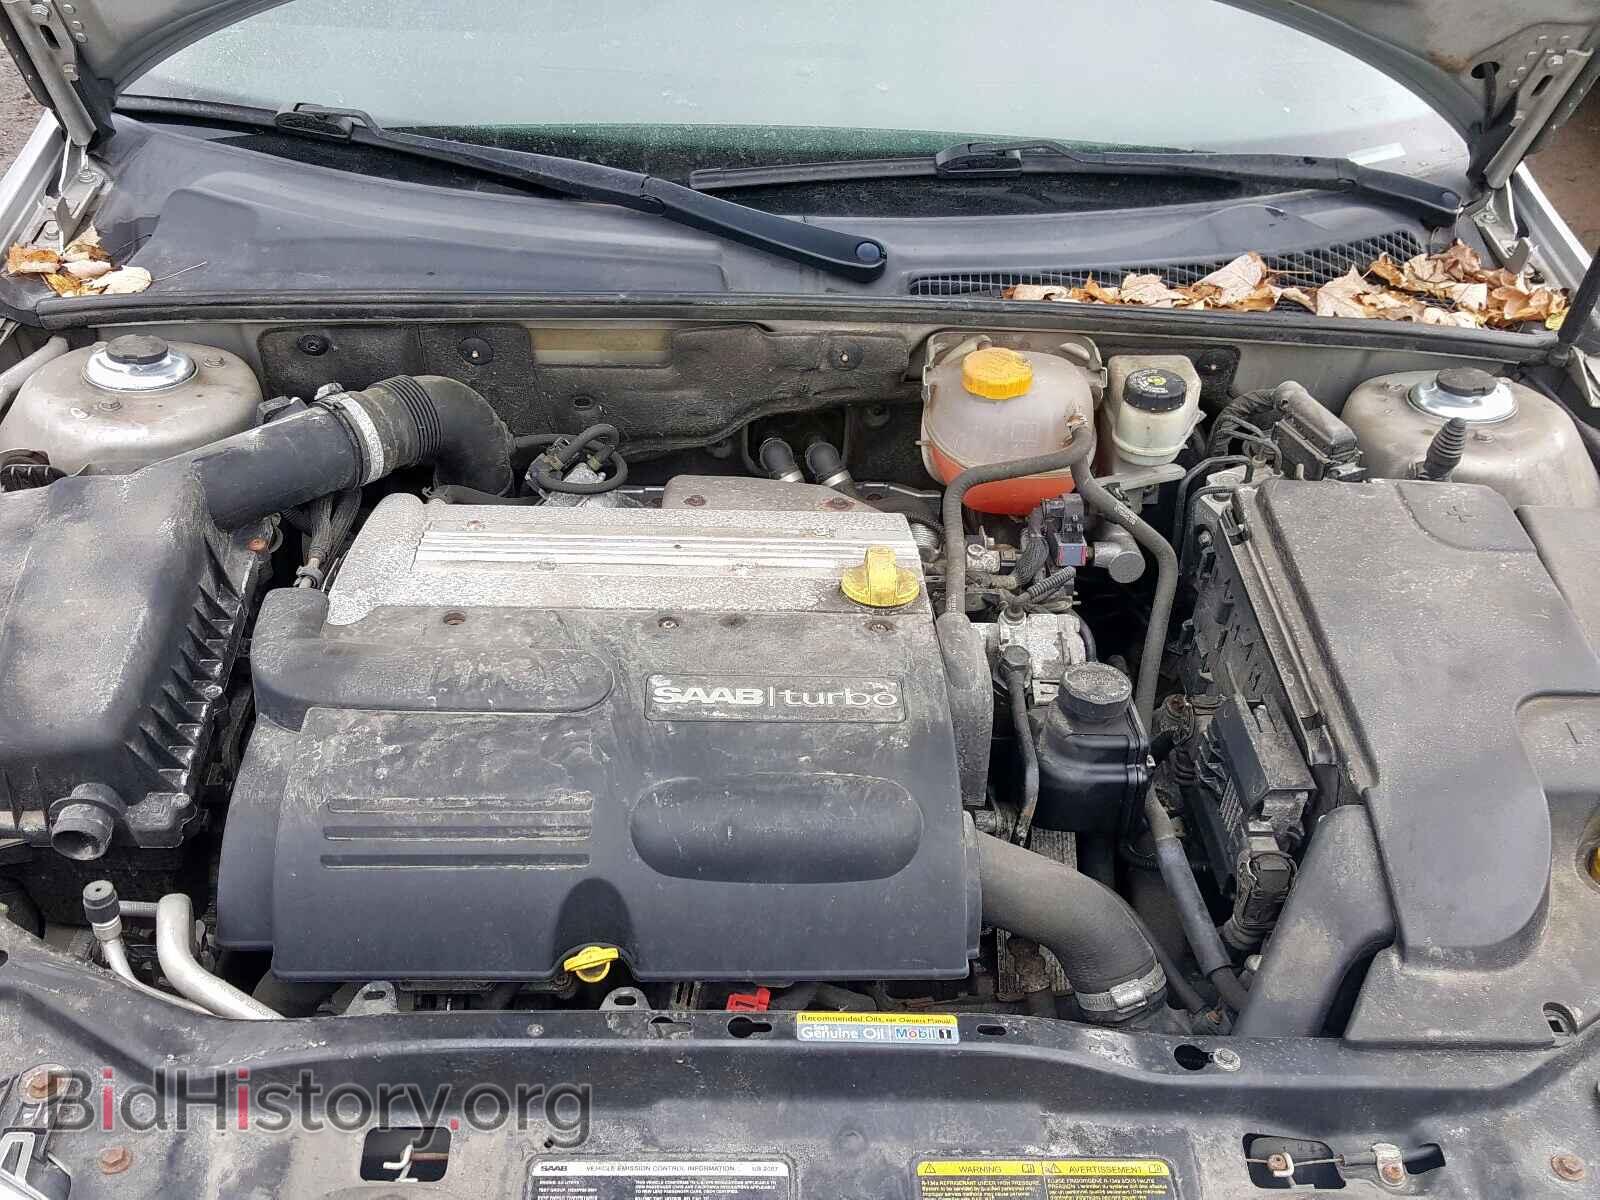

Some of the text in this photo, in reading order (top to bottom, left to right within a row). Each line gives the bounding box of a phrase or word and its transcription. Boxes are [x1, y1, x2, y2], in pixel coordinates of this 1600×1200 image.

[652, 687, 898, 707] SAAB turbo
[801, 1027, 884, 1040] Genuine Oil
[895, 1028, 936, 1040] Mobil
[958, 1165, 1002, 1173] WARNING
[1068, 1165, 1143, 1174] AVERTISSEMENT
